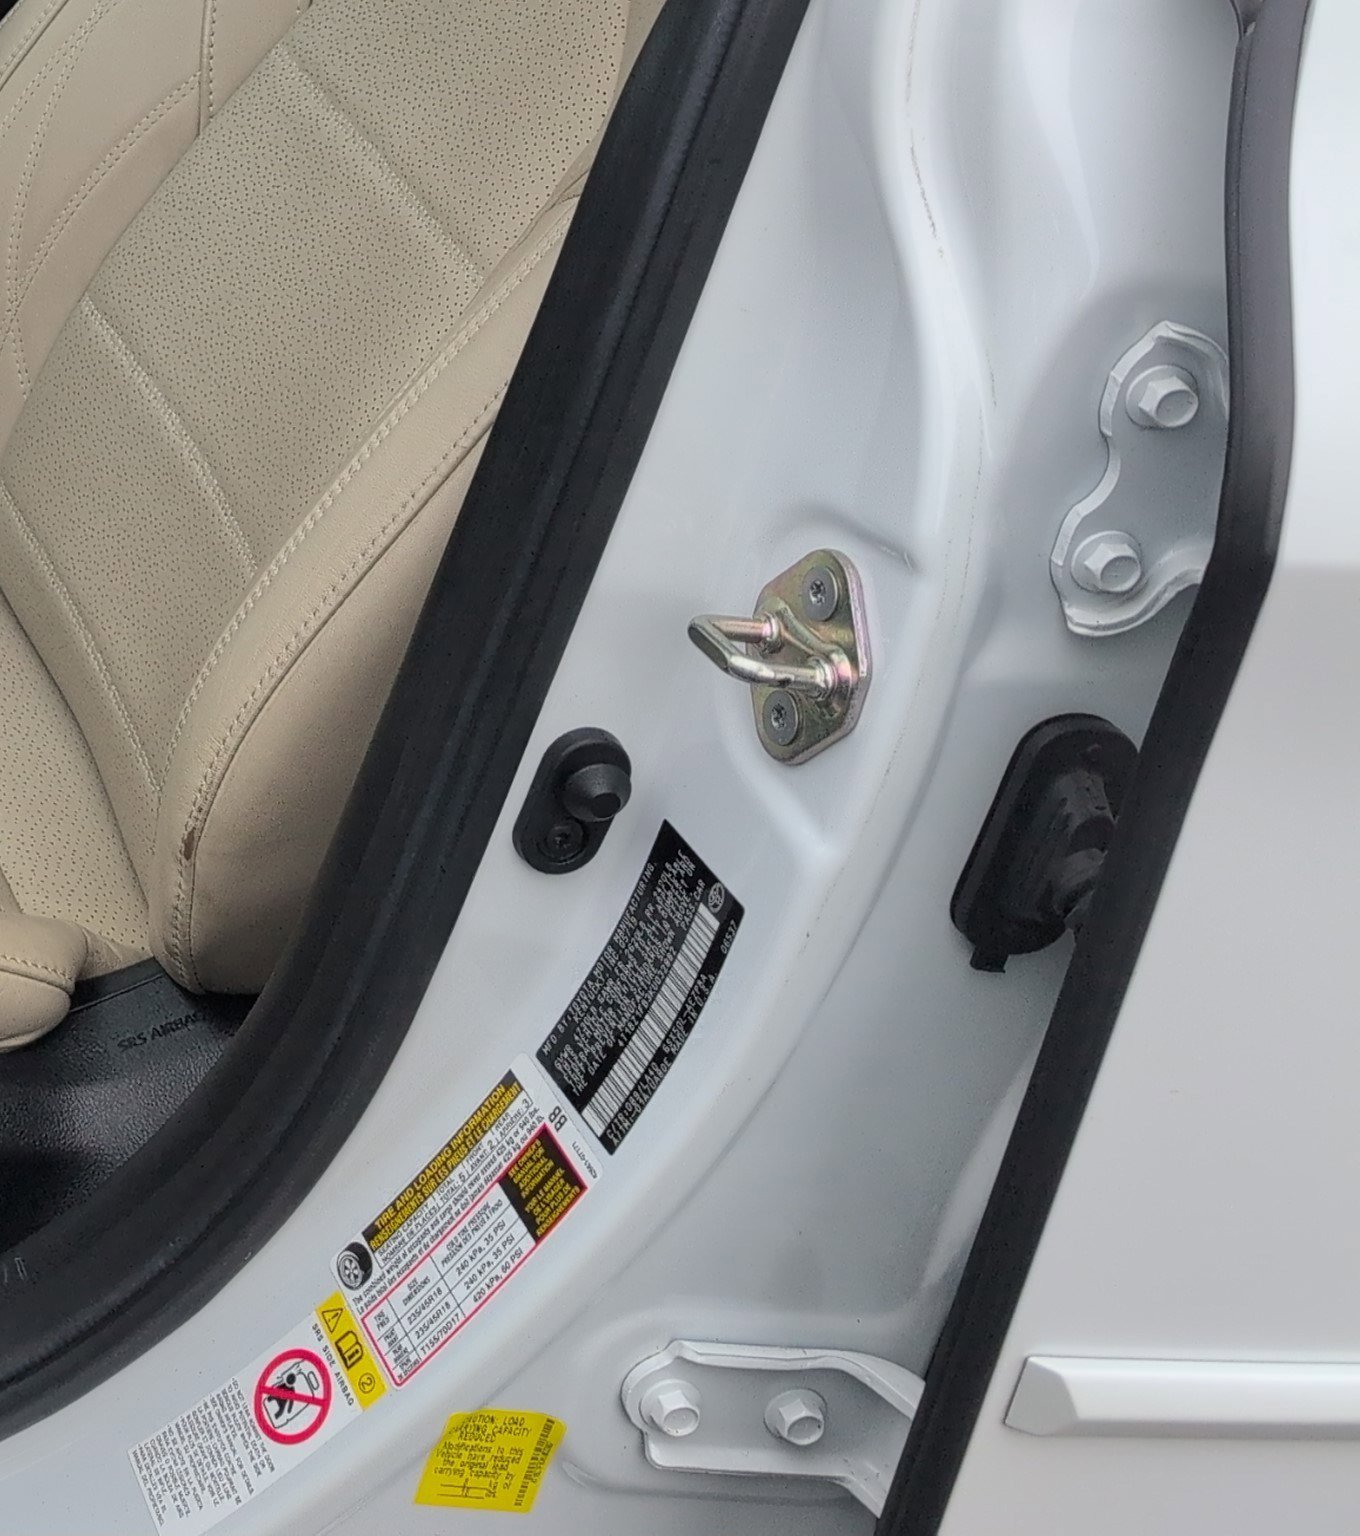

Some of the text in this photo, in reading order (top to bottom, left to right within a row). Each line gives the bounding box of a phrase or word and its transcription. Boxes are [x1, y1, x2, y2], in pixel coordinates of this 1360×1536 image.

[521, 1097, 530, 1110] 3
[546, 1104, 568, 1132] BB
[374, 1082, 506, 1230] TIRE AND LOADING INFORMATION
[420, 1176, 438, 1198] SUR
[434, 1164, 449, 1183] LES
[446, 1142, 468, 1170] PNEUS
[464, 1132, 477, 1149] ET
[472, 1124, 484, 1140] LE
[480, 1080, 521, 1131] CHARGEMENT
[485, 1138, 495, 1151] 2
[457, 1170, 466, 1183] 5
[454, 1257, 470, 1276] 240
[483, 1231, 495, 1247] 35
[492, 1218, 507, 1237] PSI
[462, 1271, 478, 1291] 240
[491, 1245, 503, 1261] 35
[500, 1232, 515, 1251] PSI
[471, 1285, 486, 1304] 420
[499, 1259, 511, 1274] 60
[508, 1245, 524, 1264] PSI
[406, 1285, 443, 1326] 235/45R18
[310, 1322, 355, 1407] SRS SIDE AIRBAG
[490, 1425, 531, 1437] CAPACITY
[502, 1416, 525, 1426] LOAD
